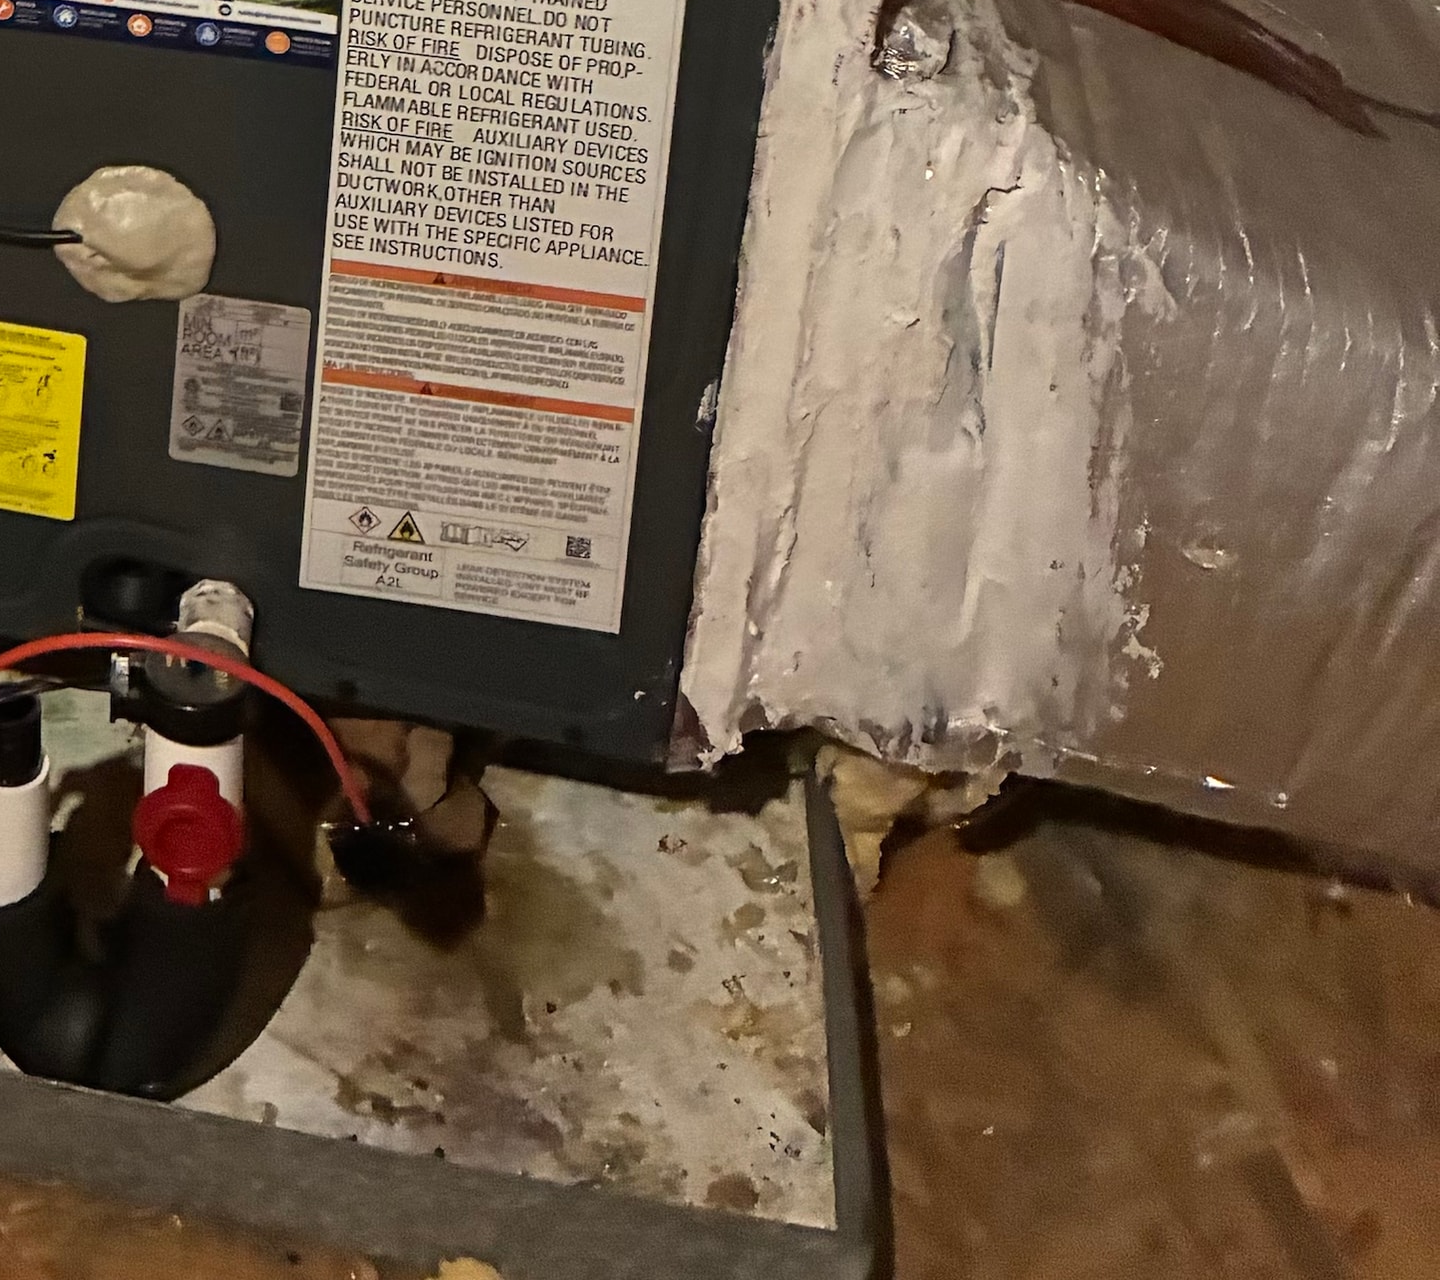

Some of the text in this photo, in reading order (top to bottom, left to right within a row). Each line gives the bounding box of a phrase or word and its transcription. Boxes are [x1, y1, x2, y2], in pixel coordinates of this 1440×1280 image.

[348, 7, 445, 35] PUNCTURE
[450, 19, 574, 49] REFRIGERANT
[578, 35, 651, 60] TUBING.
[573, 13, 613, 33] NOT
[345, 48, 593, 95] ERLY IN ACCORDANCE WITH
[346, 27, 388, 48] RISK
[392, 33, 417, 51] OF
[421, 36, 460, 57] FIRE
[475, 43, 553, 69] DISPOSE
[557, 53, 582, 71] OF
[342, 90, 637, 142] FLAMMABLE REFRIGERANT USED.
[344, 69, 651, 123] FEDERAL OR LOCAL REGULATIONS.
[339, 130, 647, 185] WHICH MAY BE IGNITION SOURCES
[341, 110, 648, 164] RISK OF FIRE AUXILIARY DEVICES
[337, 151, 630, 203] SHALL NOT BE INSTALLED IN THE
[334, 192, 614, 242] AUXILIARY DEVICES LISTED FOR
[507, 192, 555, 214] THAN
[331, 231, 502, 269] SEE INSTRUCTIONS.
[333, 211, 648, 267] USE WITH THE SPECIFIC APPLIANCE.
[341, 553, 441, 581] Safety Group
[351, 538, 434, 566] Refrigerant
[374, 572, 404, 589] A2L
